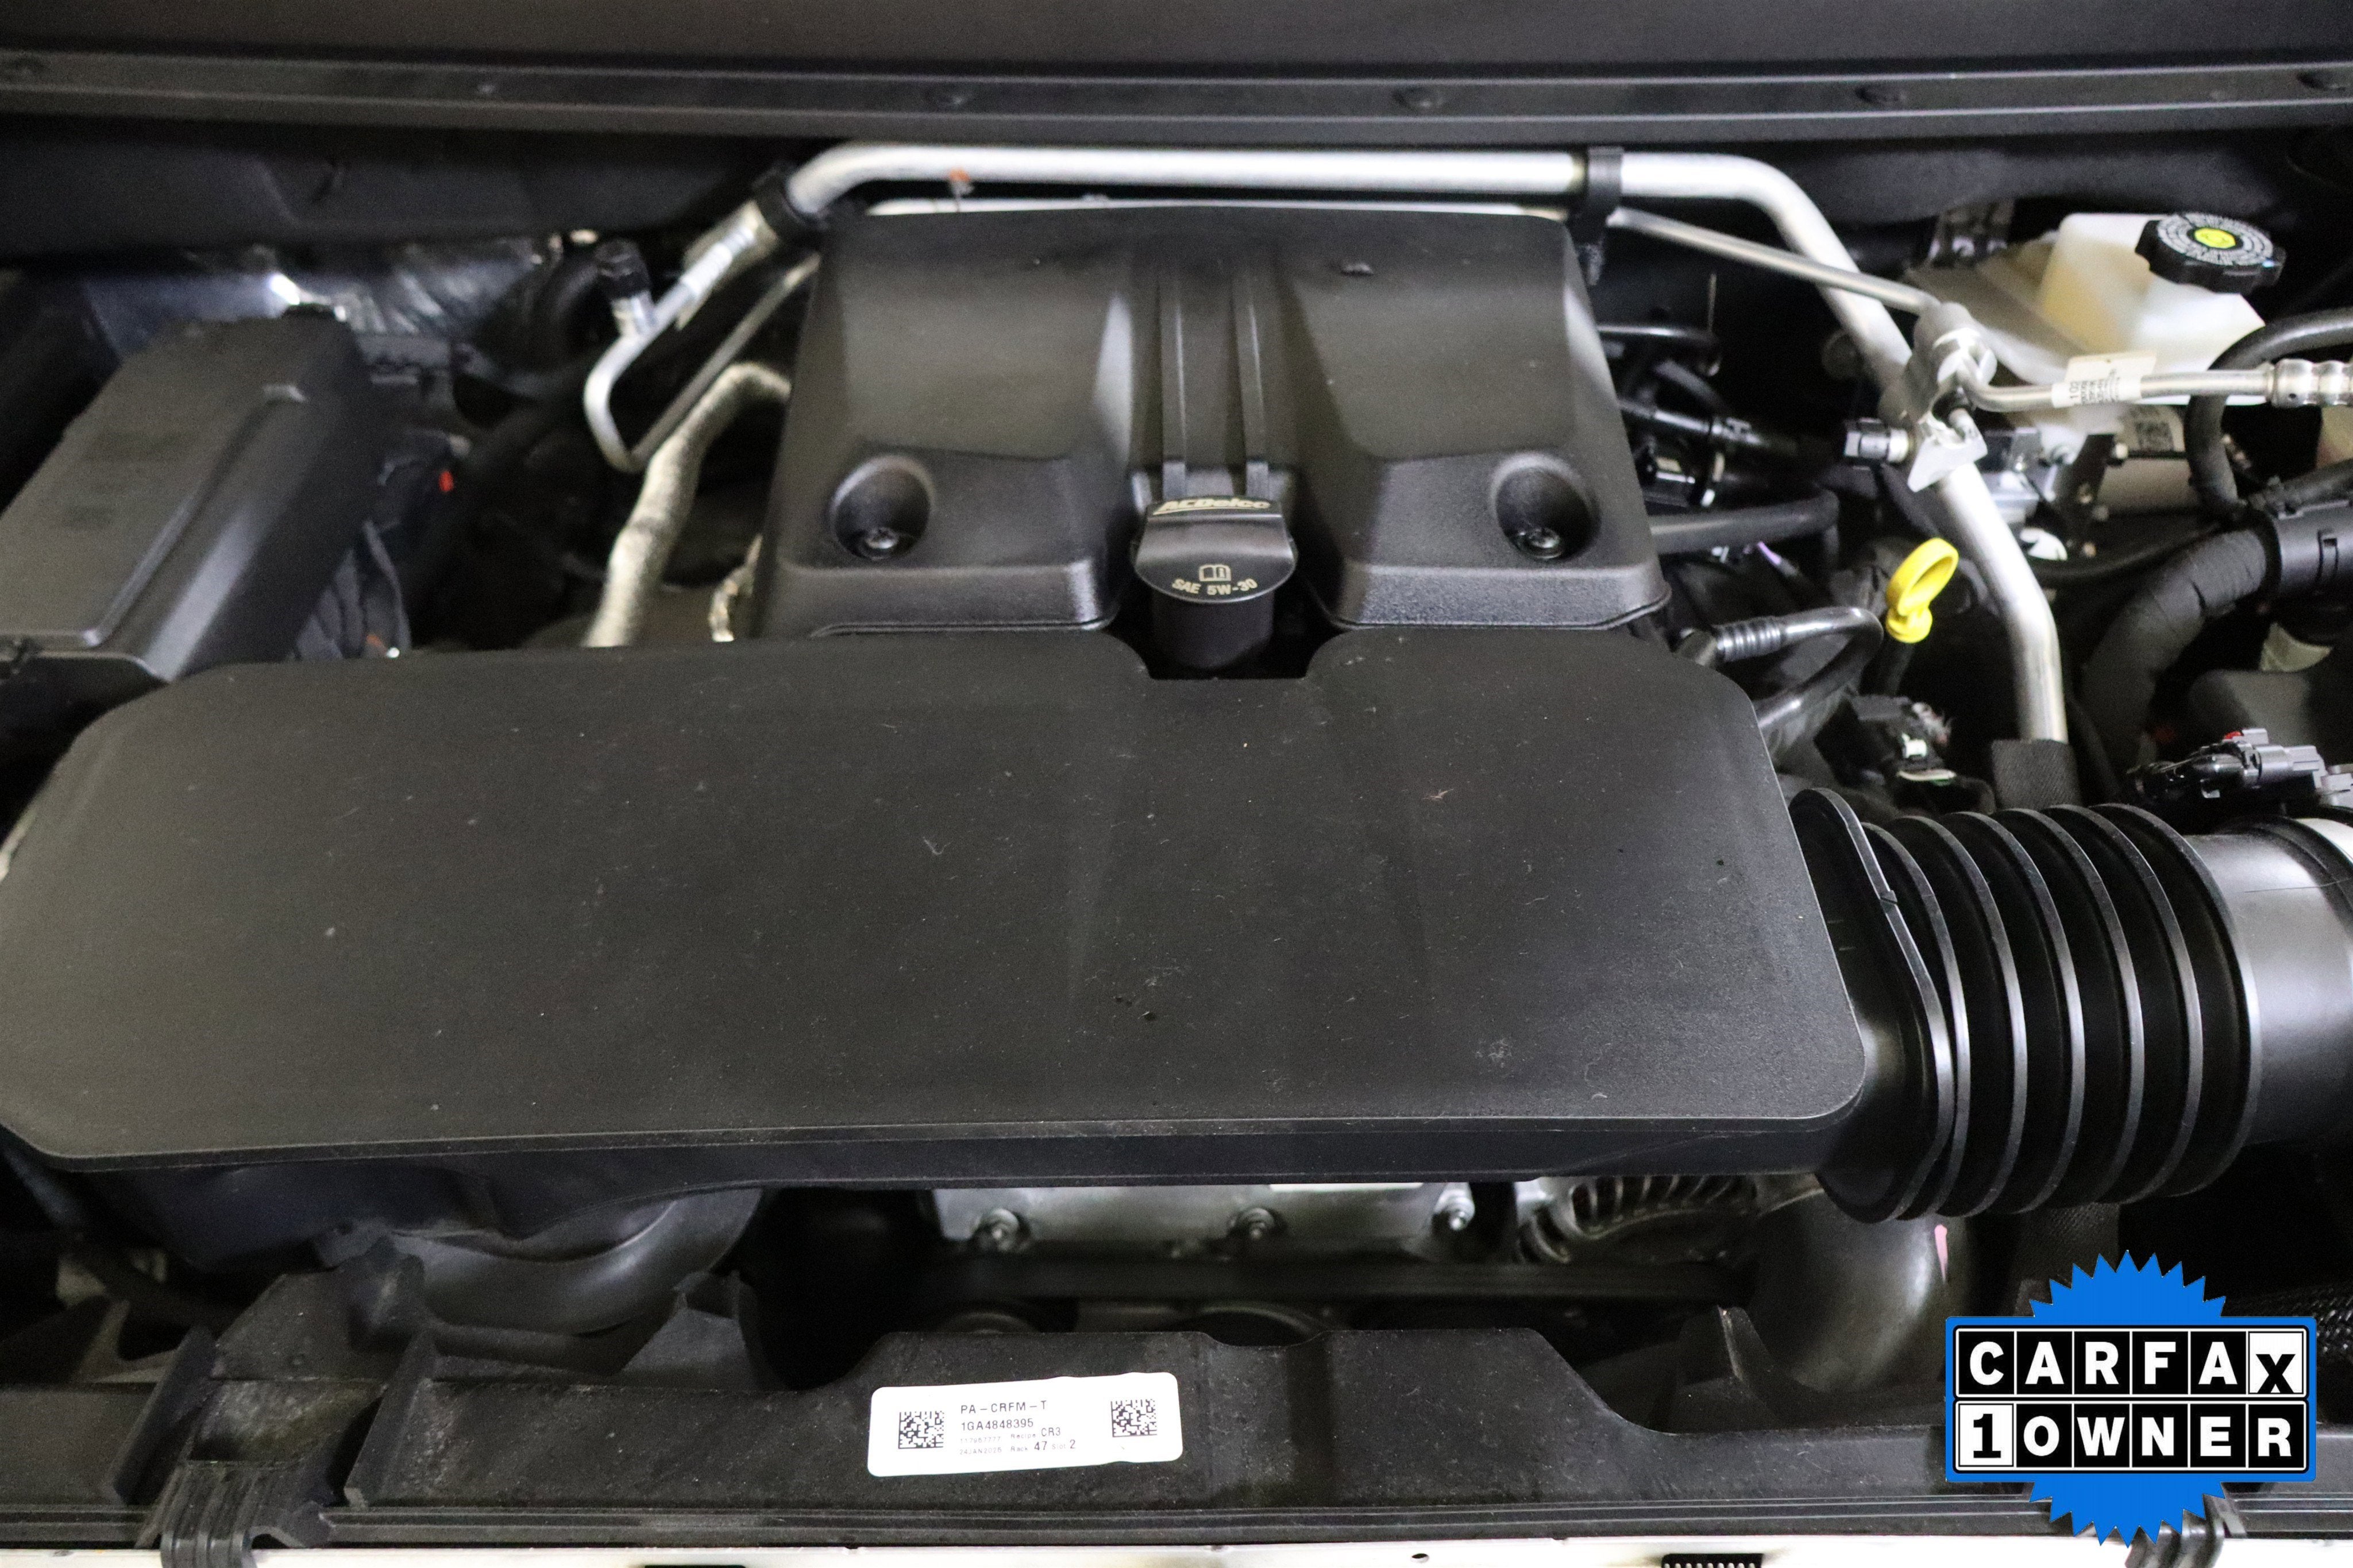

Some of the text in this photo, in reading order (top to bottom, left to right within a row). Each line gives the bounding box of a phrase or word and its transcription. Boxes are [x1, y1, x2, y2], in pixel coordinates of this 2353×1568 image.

[1154, 498, 1270, 514] ACDelco
[1172, 578, 1258, 596] SAE 5W-30
[961, 1418, 1033, 1431] 1GA4848395
[1041, 1427, 1061, 1437] CR3
[1034, 1440, 1047, 1451] 47
[1070, 1439, 1076, 1449] 2
